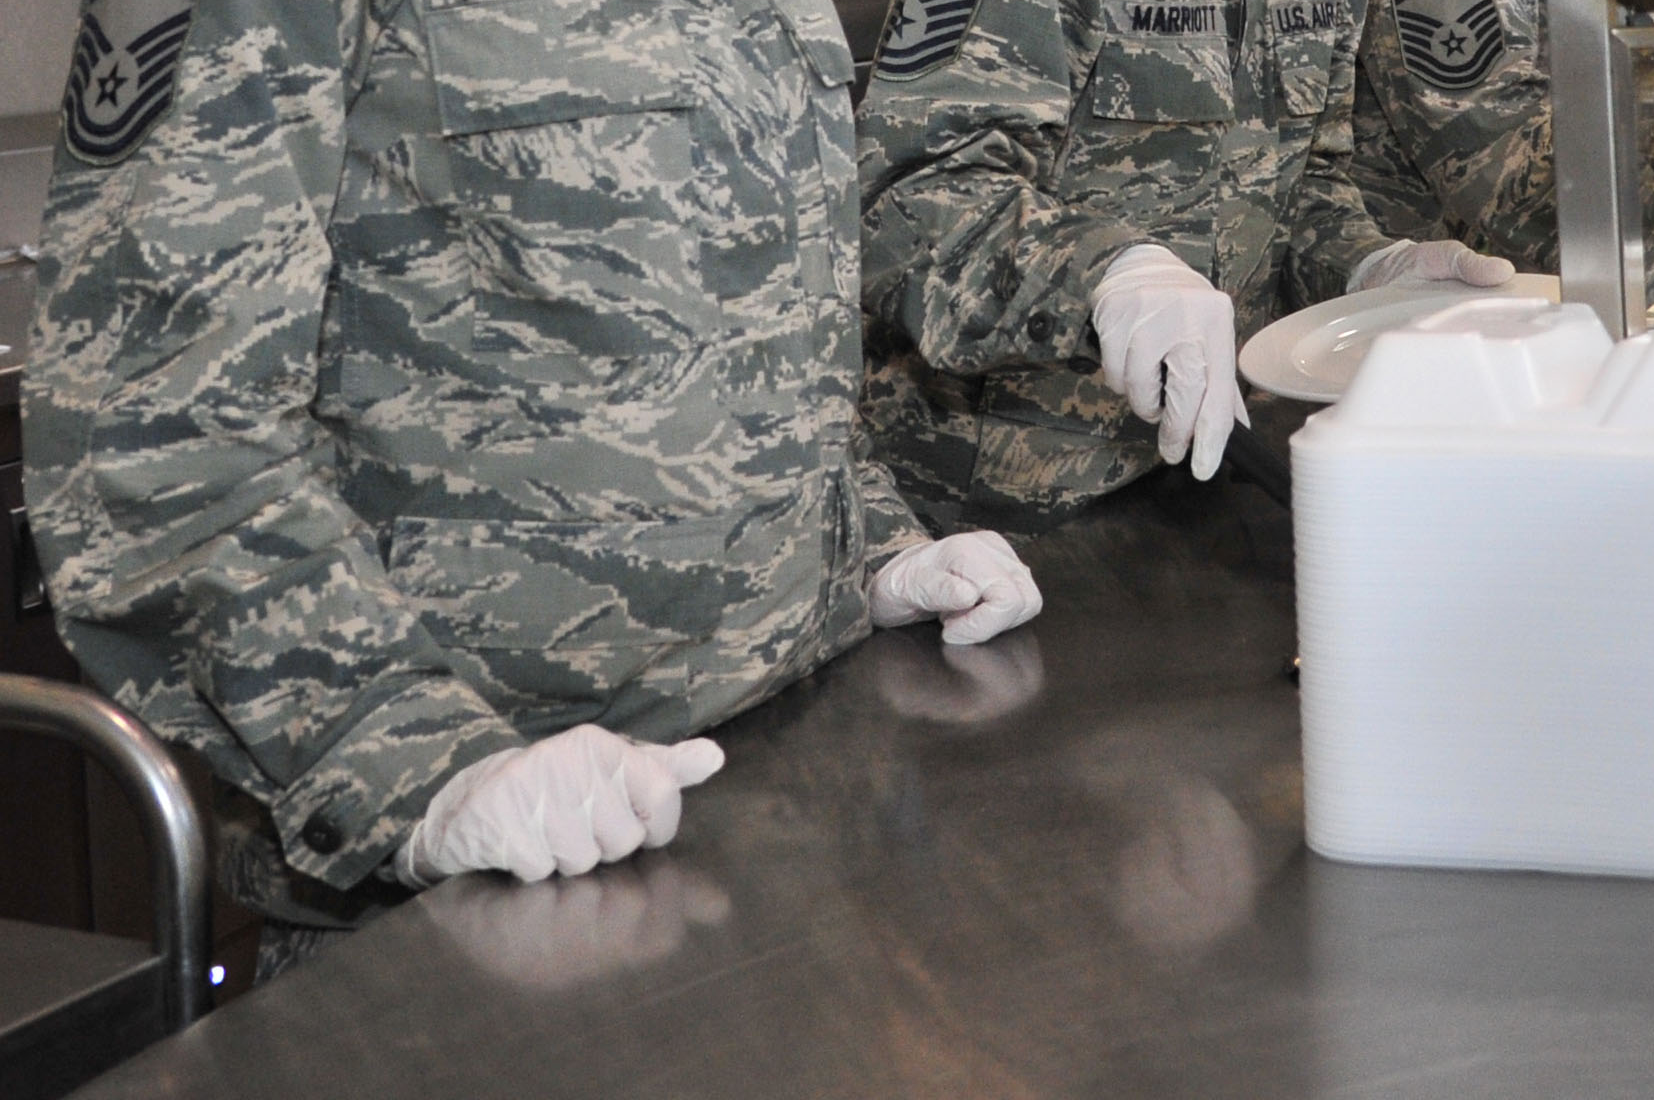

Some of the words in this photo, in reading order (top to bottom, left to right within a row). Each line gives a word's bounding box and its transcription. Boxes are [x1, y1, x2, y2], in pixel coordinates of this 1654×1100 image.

[1132, 5, 1216, 32] MARRIOTT
[1276, 6, 1309, 32] U.S.
[1312, 2, 1334, 28] AIR
